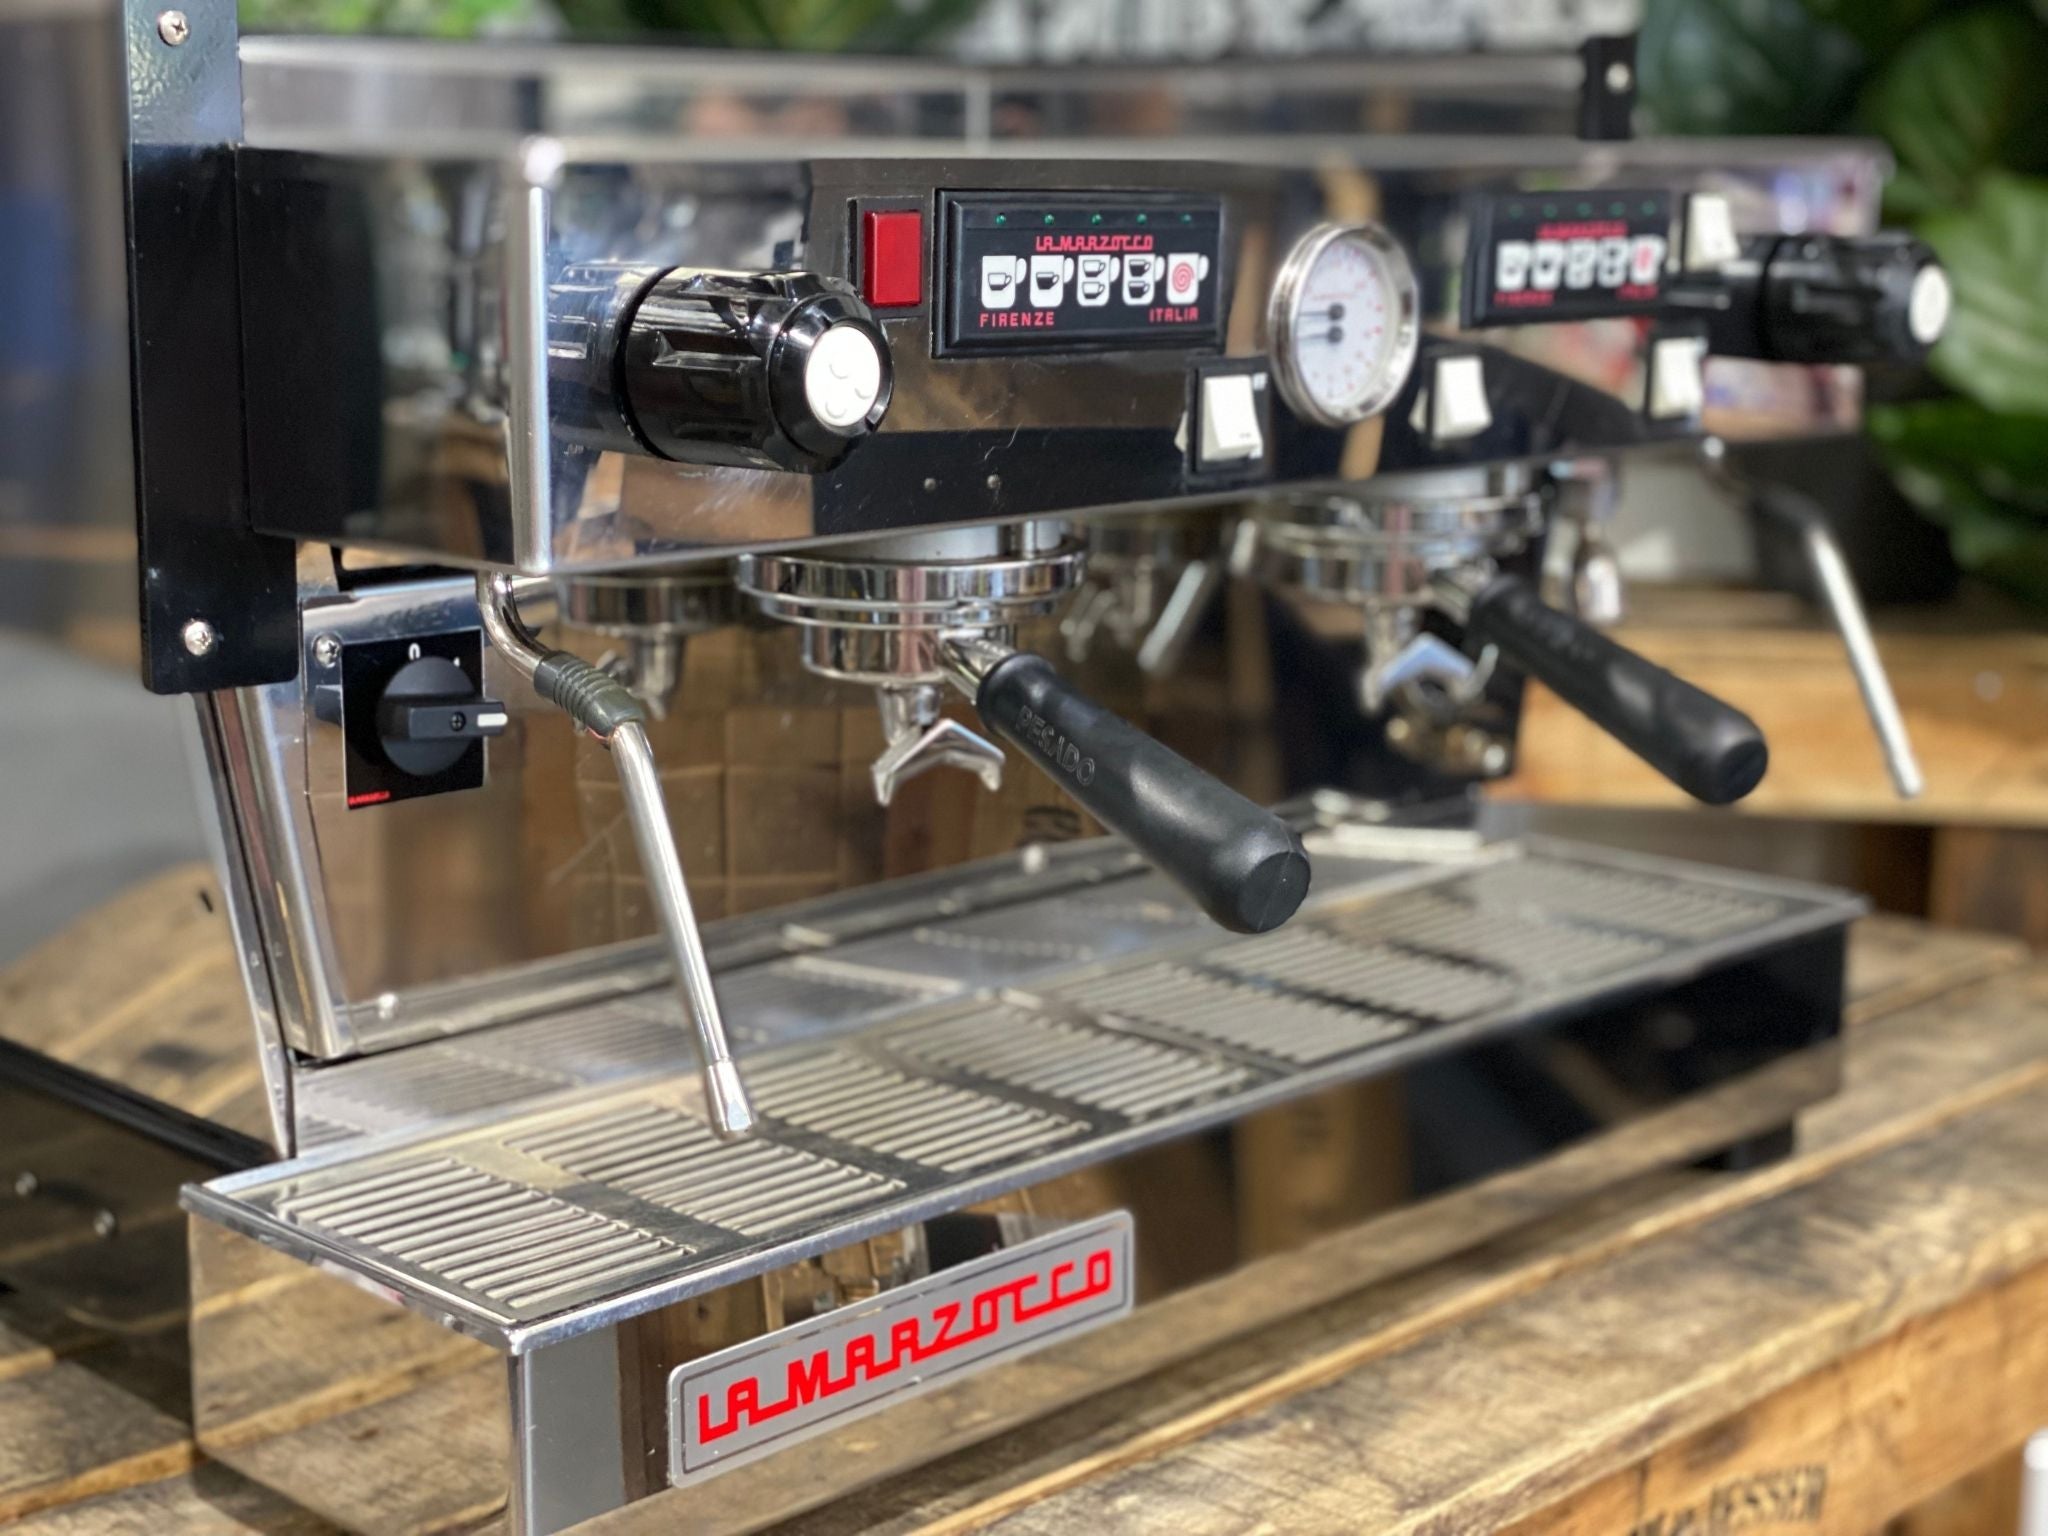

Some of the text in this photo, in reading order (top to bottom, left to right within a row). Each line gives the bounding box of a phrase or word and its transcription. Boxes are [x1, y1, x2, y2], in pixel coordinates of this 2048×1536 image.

[1060, 234, 1153, 251] MARZOCCO
[979, 311, 1055, 327] FIRENZE
[1149, 307, 1198, 323] ITALIA
[699, 1248, 1112, 1445] LA MARZOCCO
